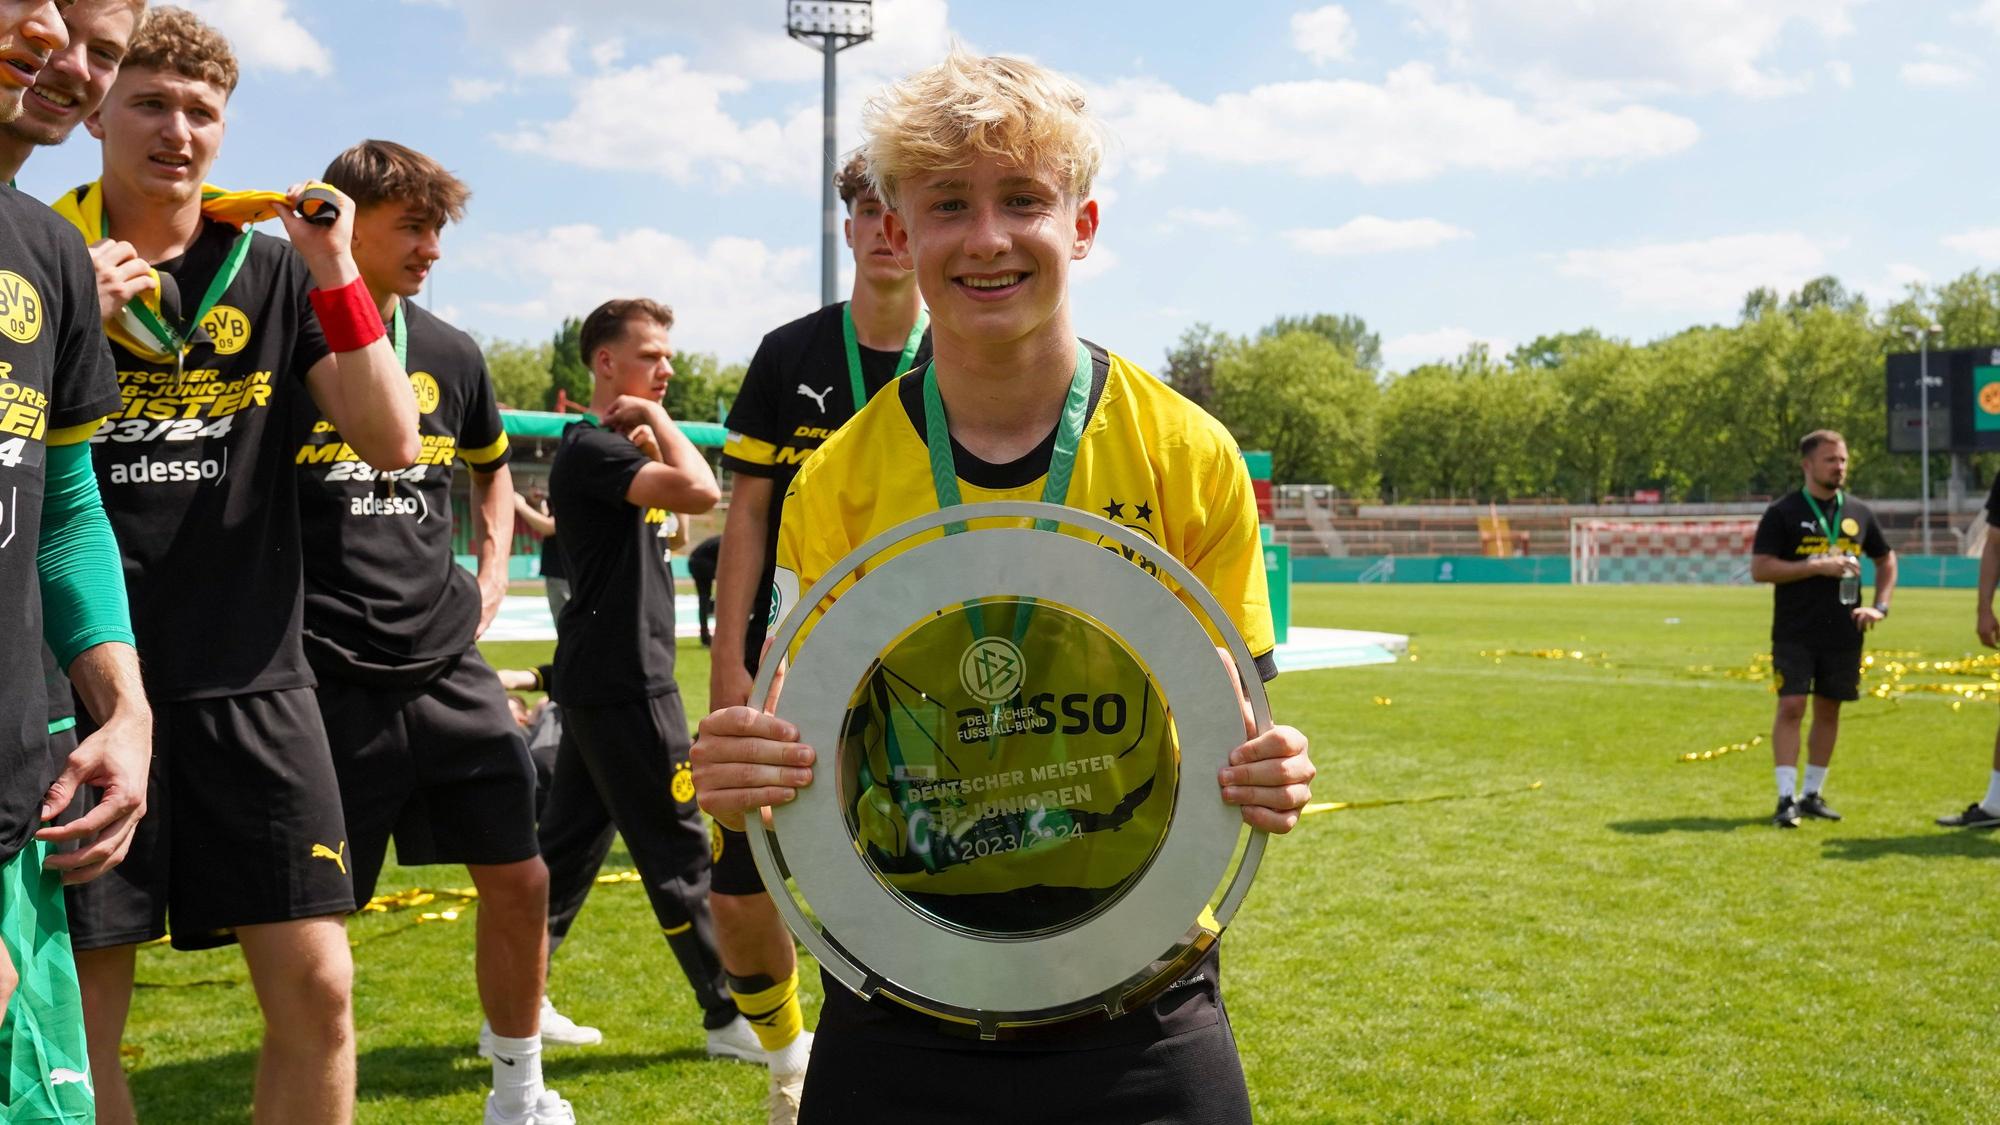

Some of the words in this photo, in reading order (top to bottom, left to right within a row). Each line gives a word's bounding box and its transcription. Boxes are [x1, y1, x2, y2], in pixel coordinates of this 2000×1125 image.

[10, 318, 25, 335] 09
[205, 311, 244, 339] BVB
[219, 338, 233, 348] 09
[117, 369, 220, 384] TSCHER
[107, 384, 272, 420] EISTER
[957, 717, 1048, 741] FUSSBALL-BUND
[967, 707, 1035, 727] DEUTSCHER
[907, 770, 1025, 803] DEUTSCHER
[1031, 755, 1116, 782] MEISTER
[940, 784, 1092, 827] B-JUNIOREN
[961, 822, 1085, 861] 2023/2024
